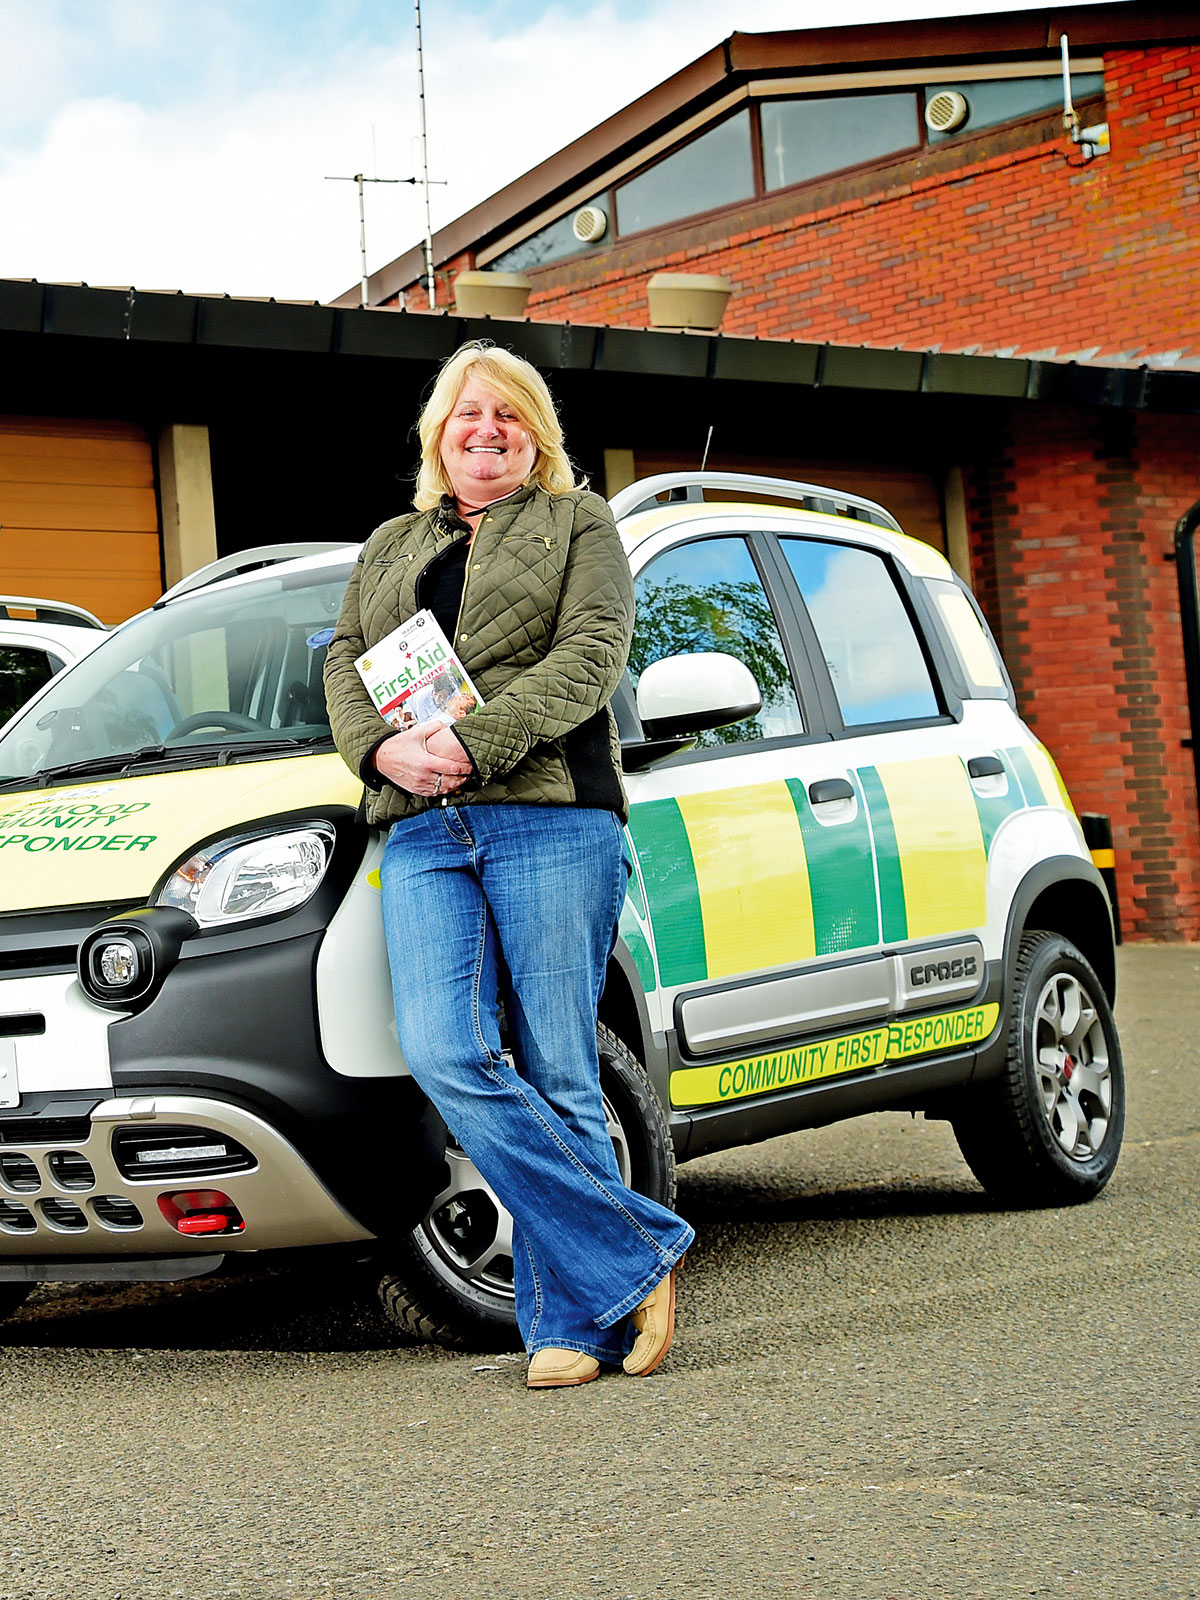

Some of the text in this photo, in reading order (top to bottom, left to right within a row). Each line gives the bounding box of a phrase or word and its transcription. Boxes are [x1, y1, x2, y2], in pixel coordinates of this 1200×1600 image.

[373, 667, 416, 705] First
[417, 642, 447, 675] Aid
[410, 665, 446, 694] MANUAL
[718, 1010, 984, 1098] COMMUNITY FIRST RESPONDER
